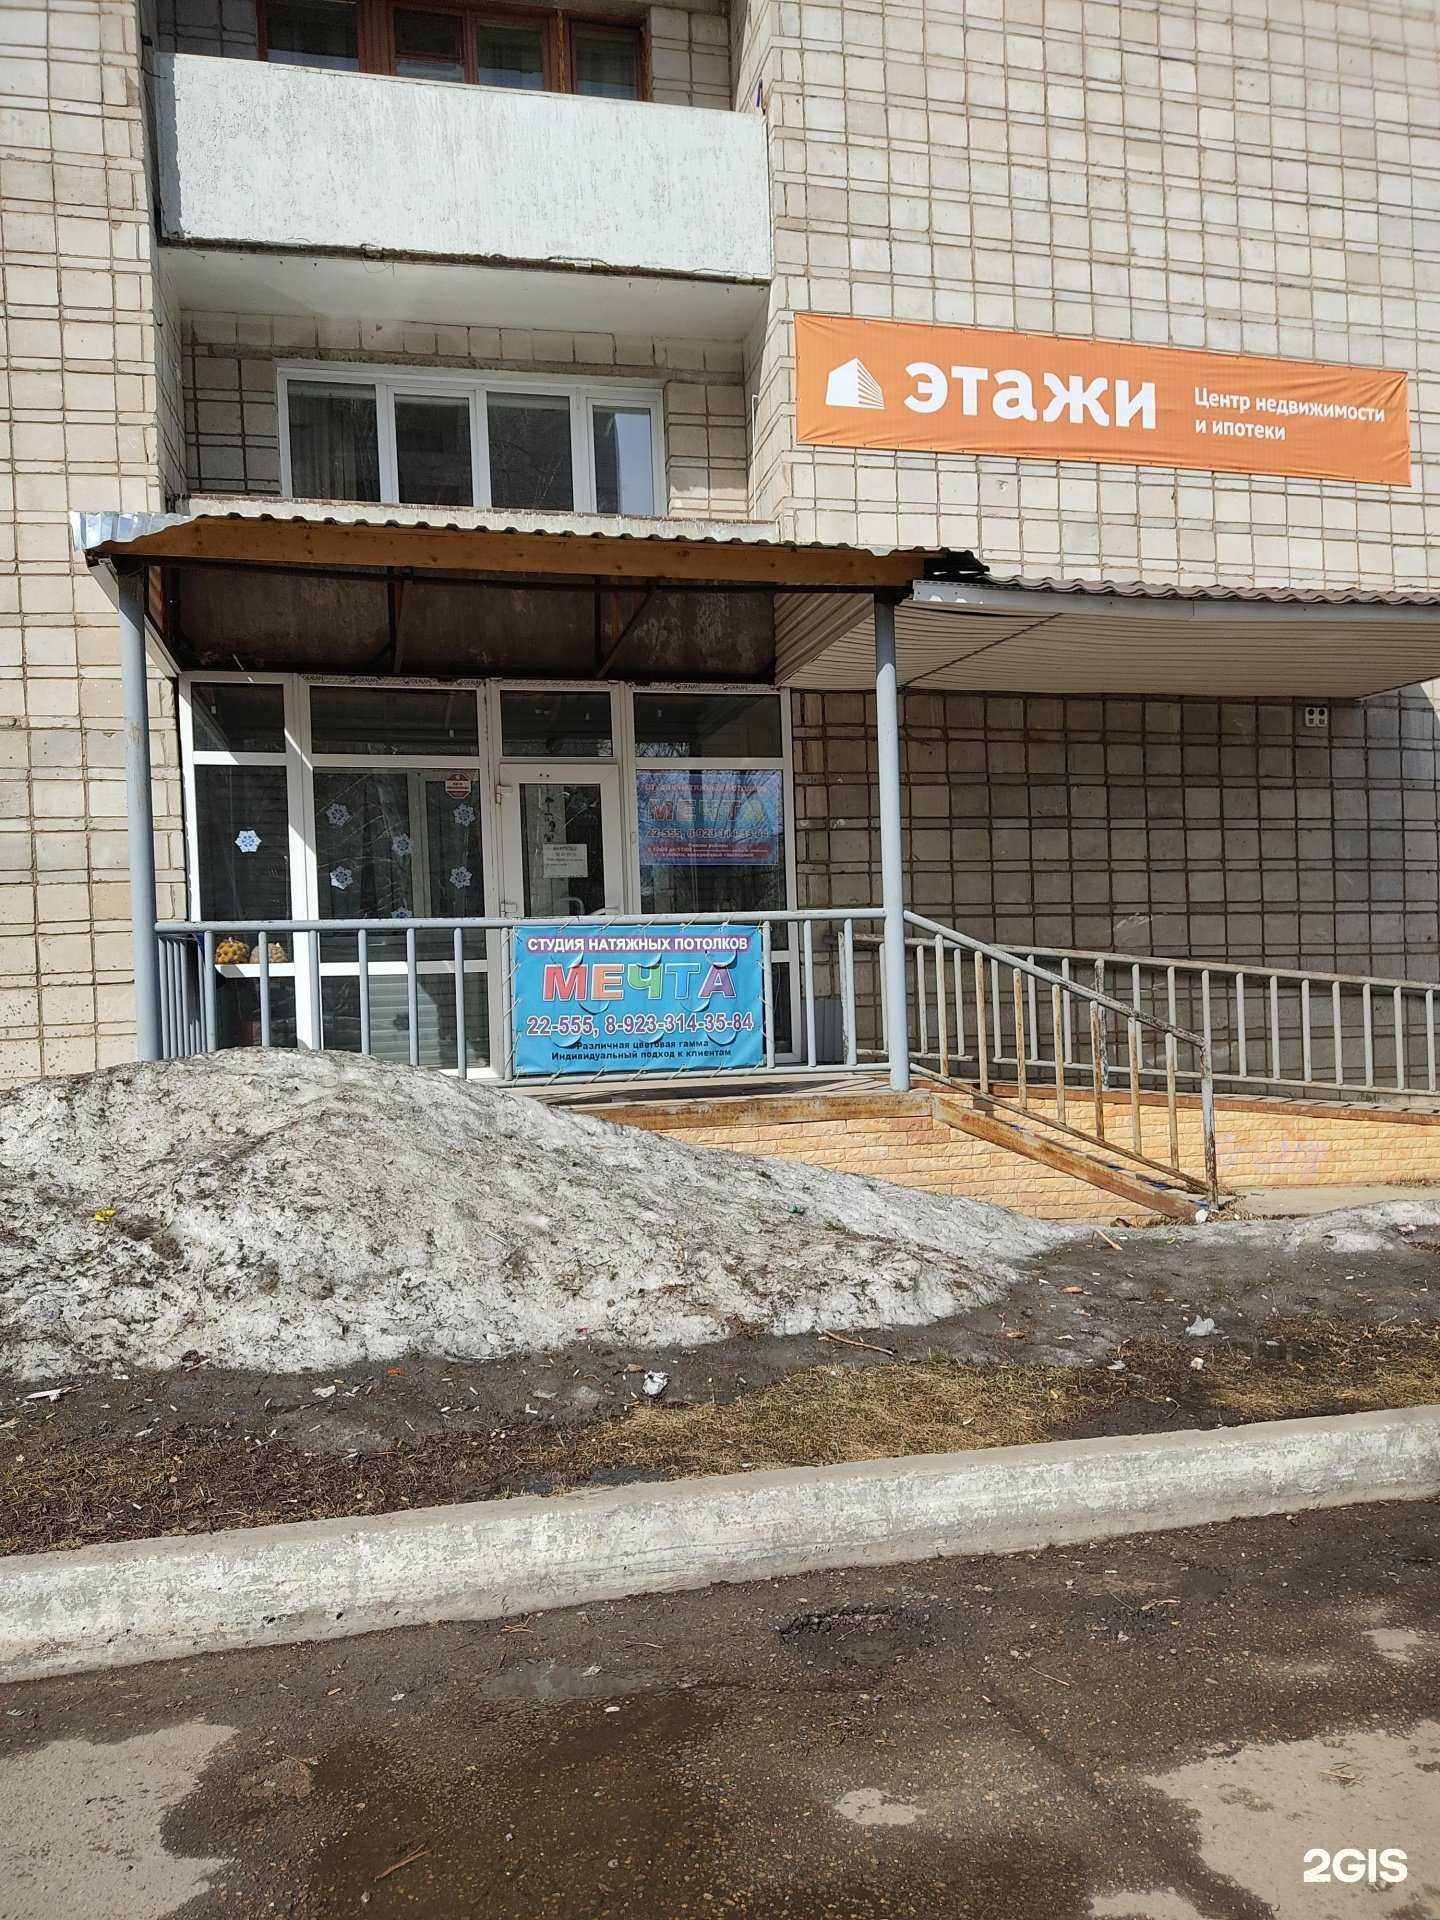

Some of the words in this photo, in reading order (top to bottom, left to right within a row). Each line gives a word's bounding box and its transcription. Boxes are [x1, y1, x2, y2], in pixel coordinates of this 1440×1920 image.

[903, 360, 1158, 430] этажи
[1194, 386, 1251, 413] Центр
[1255, 397, 1386, 423] недвижимости
[1195, 420, 1207, 434] и
[1212, 421, 1286, 441] ипотеки
[527, 938, 584, 953] СТУДИЯ
[588, 938, 670, 951] НАТЯЖНЫХ
[673, 937, 748, 951] ПОТОЛКОВ
[543, 962, 737, 1002] МЕЧТА
[527, 1016, 599, 1037] 22-555,
[604, 1012, 753, 1034] 8-923-314-35-84
[678, 1039, 709, 1048] гамма
[551, 1051, 637, 1062] Индивидуальный
[640, 1051, 675, 1061] подход
[686, 1049, 732, 1058] клиентам
